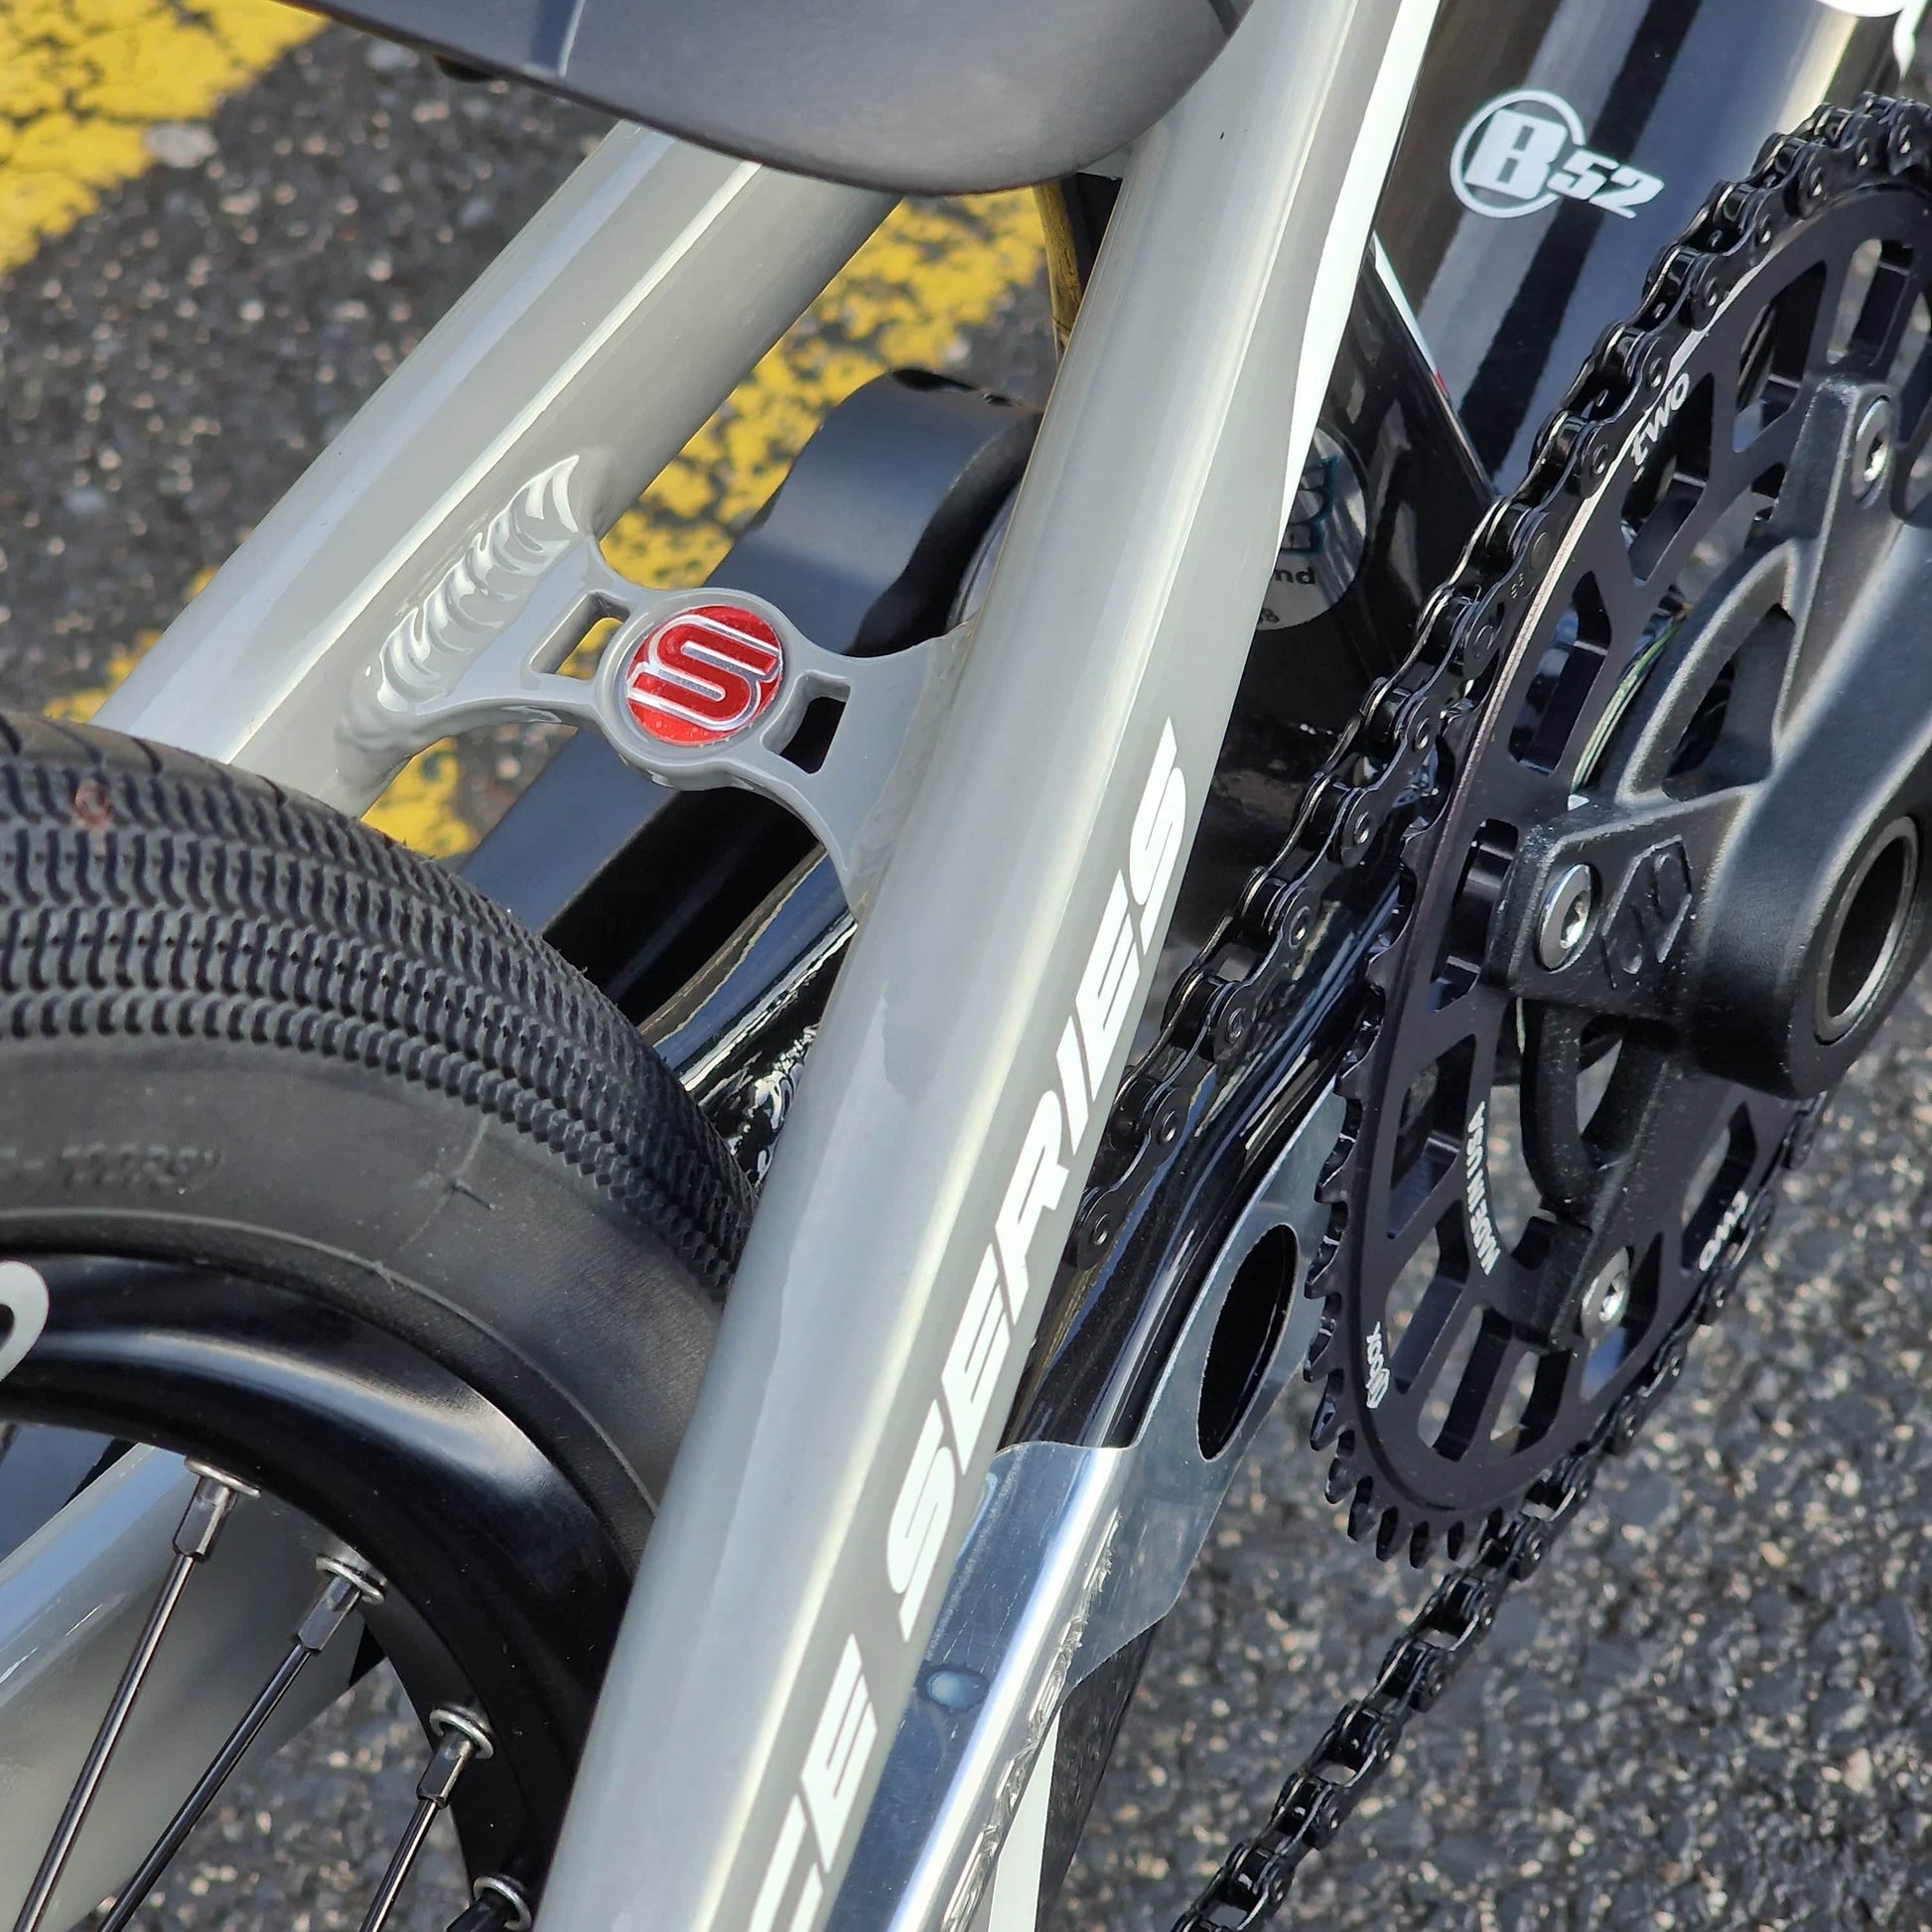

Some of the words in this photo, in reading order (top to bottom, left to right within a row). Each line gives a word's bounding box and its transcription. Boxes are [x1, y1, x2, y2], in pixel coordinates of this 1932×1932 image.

[1465, 1100, 1486, 1179] USA
[886, 717, 1187, 1643] SERIES
[1469, 1198, 1501, 1276] MADE
